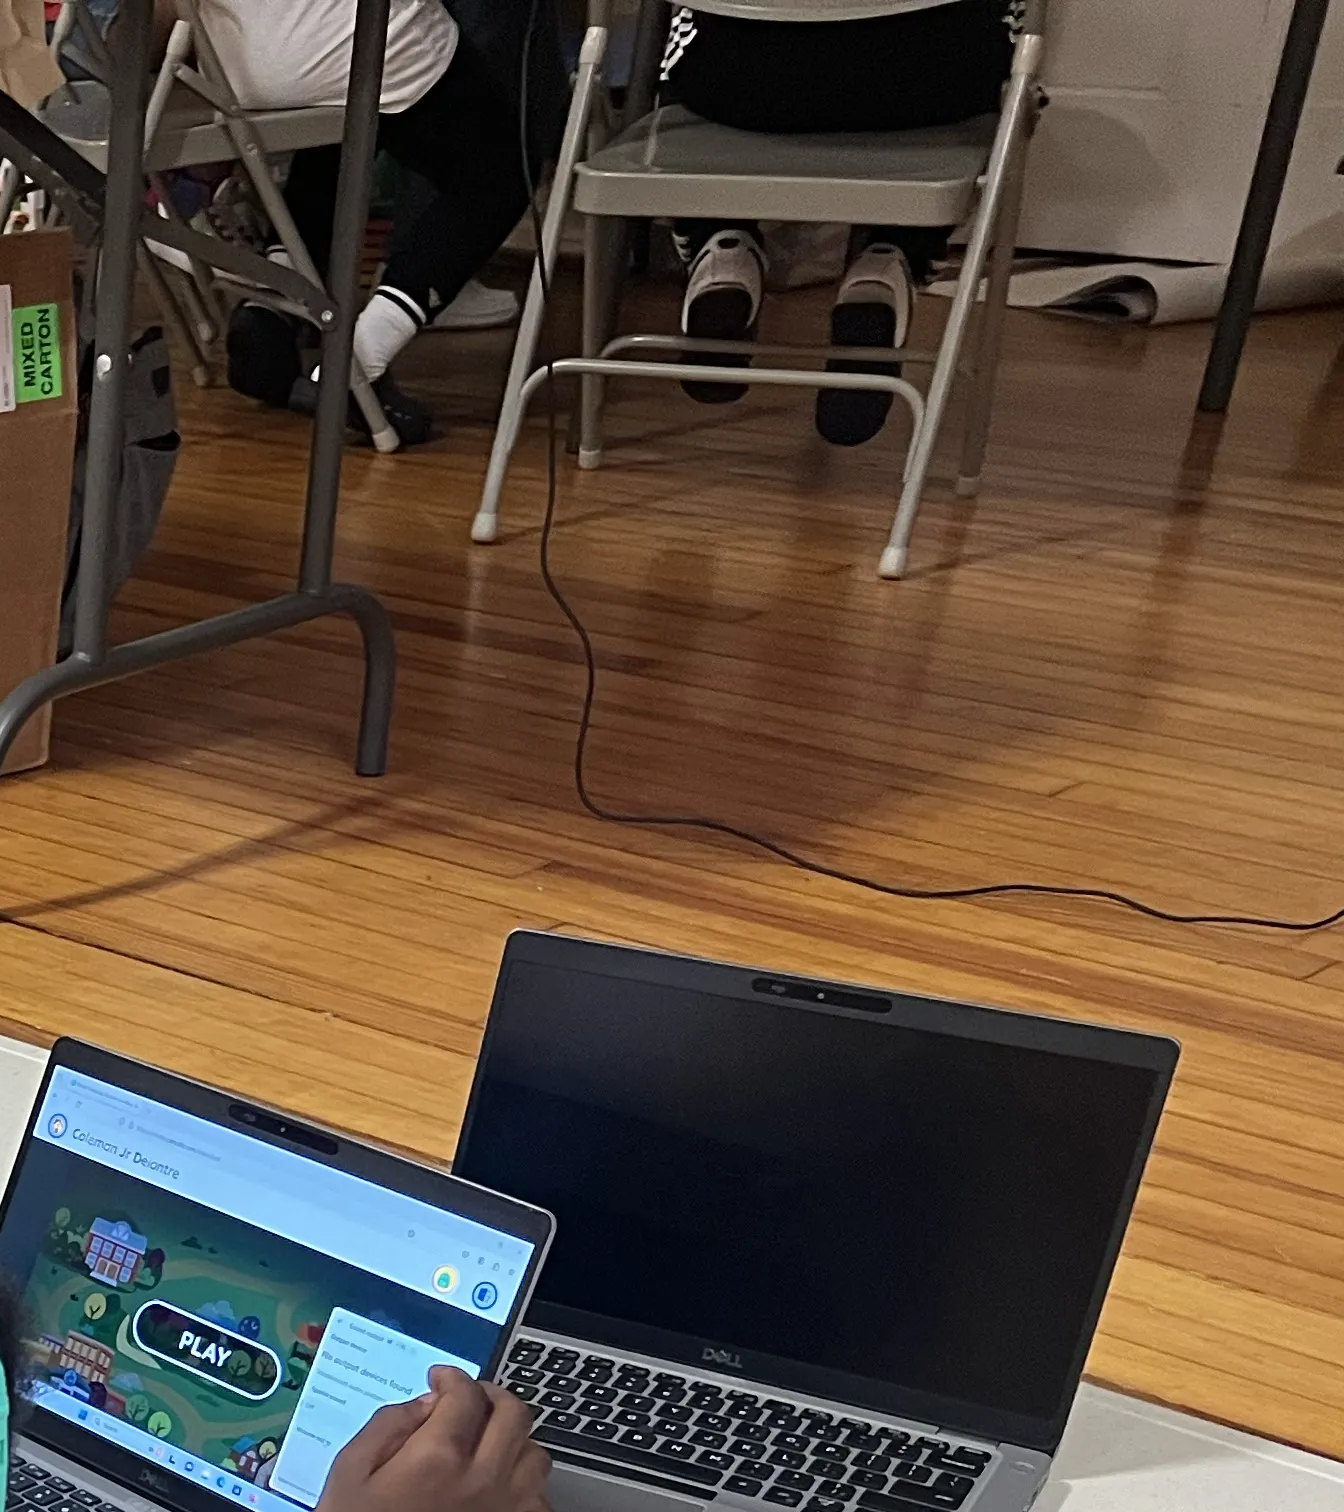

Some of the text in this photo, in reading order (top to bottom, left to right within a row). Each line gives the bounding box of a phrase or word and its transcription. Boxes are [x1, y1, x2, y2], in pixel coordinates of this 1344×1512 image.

[21, 321, 37, 387] MIXED
[37, 308, 53, 395] CARTON
[72, 1128, 119, 1156] Coleman
[118, 1147, 132, 1160] Jr
[177, 1330, 233, 1368] PLAY
[701, 1347, 744, 1369] DELL
[388, 1379, 414, 1397] found
